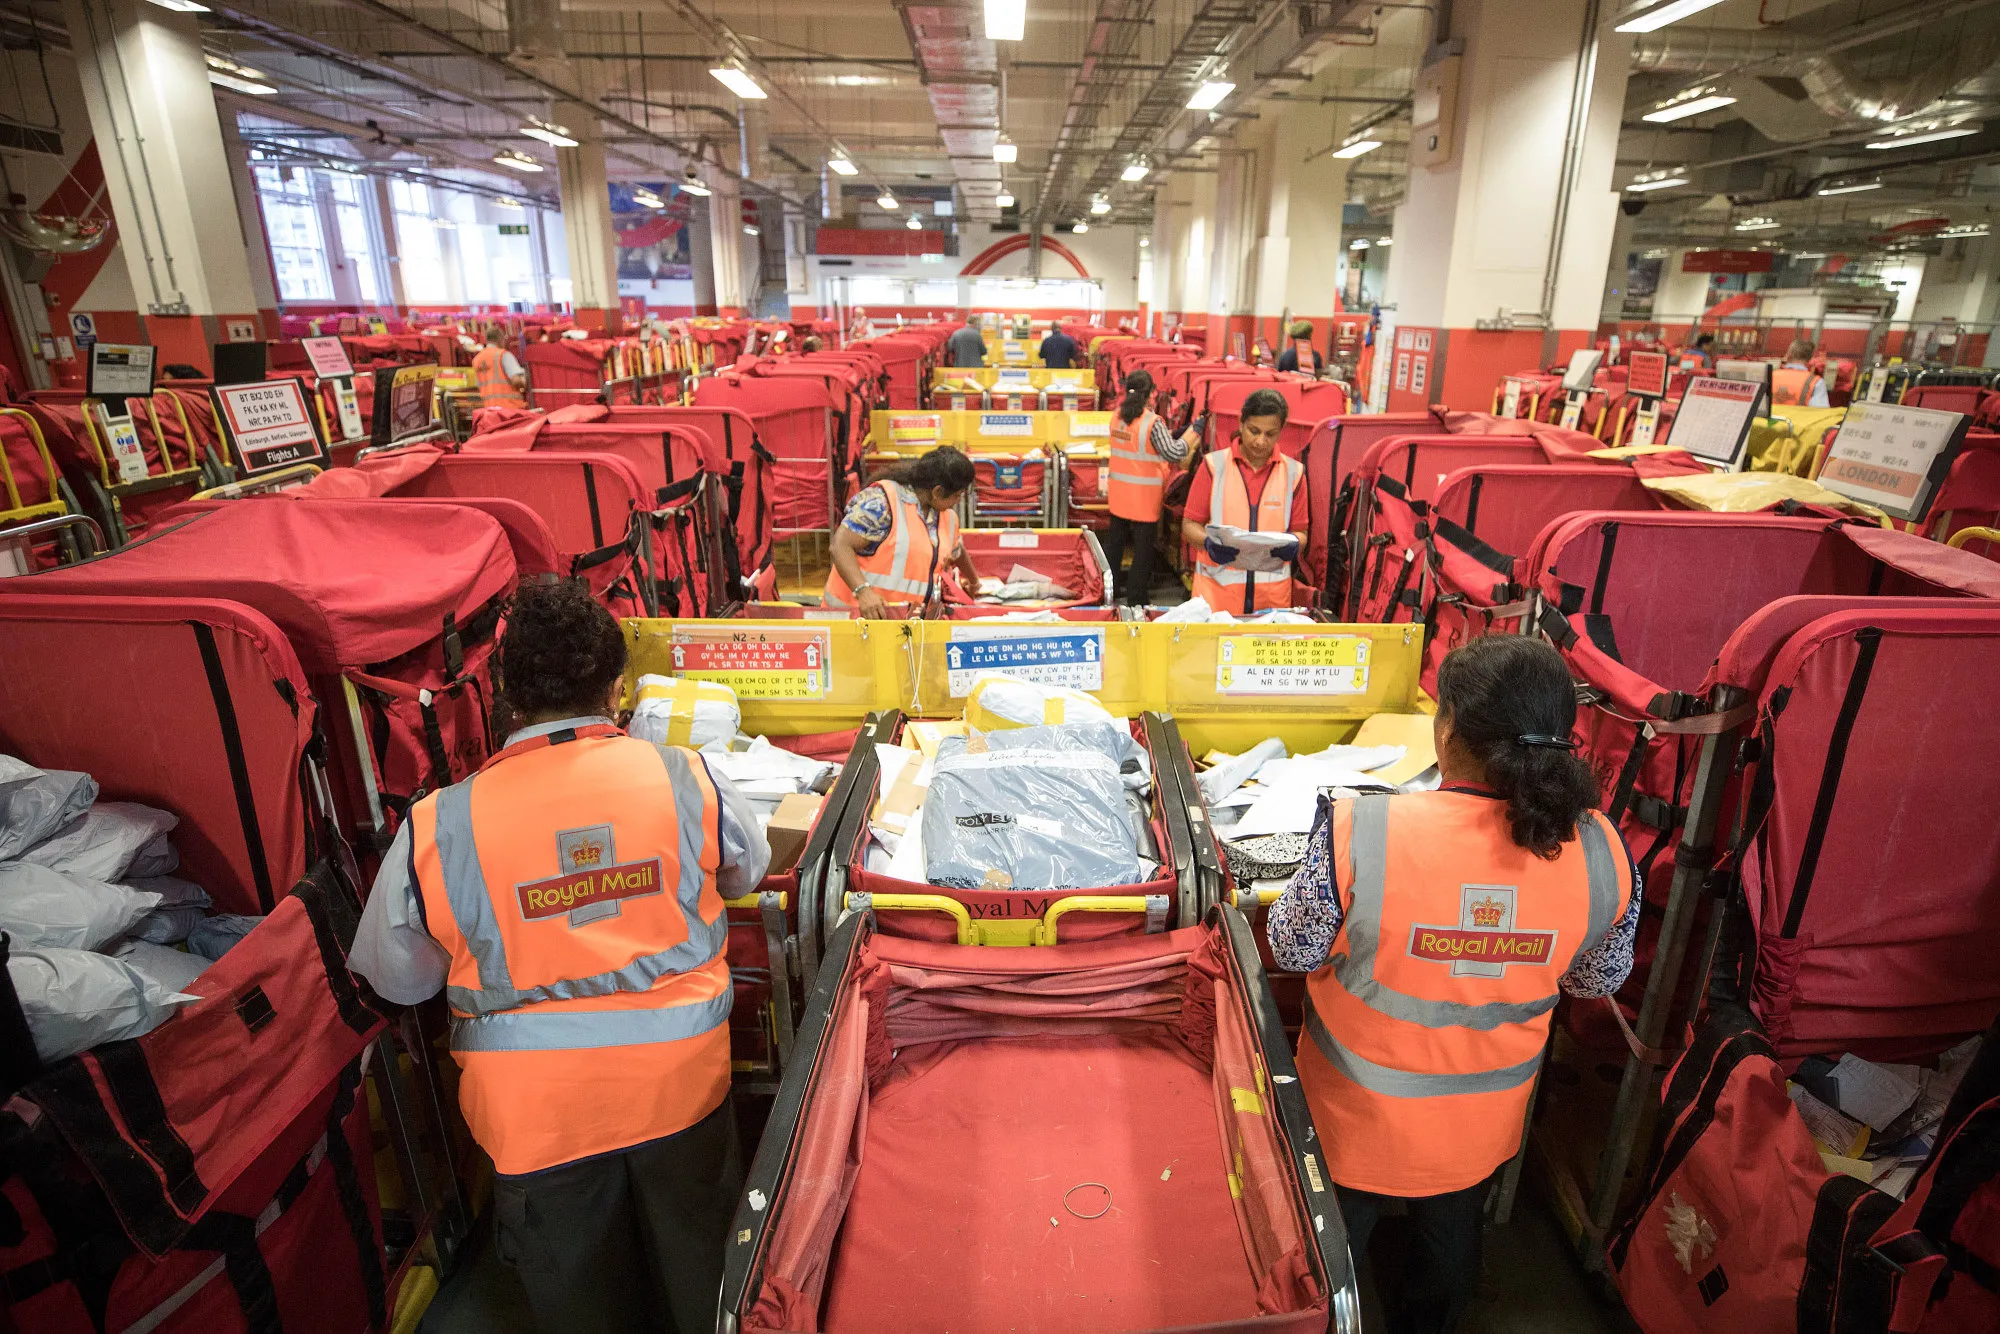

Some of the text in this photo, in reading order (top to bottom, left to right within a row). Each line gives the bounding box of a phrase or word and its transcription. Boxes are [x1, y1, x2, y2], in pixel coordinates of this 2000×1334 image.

[239, 394, 248, 402] BT
[250, 392, 262, 401] BX2
[275, 390, 284, 398] EH
[243, 406, 252, 414] FK
[260, 403, 268, 411] KA
[279, 401, 288, 409] ML
[263, 416, 272, 424] PA
[273, 415, 282, 423] PH
[283, 413, 292, 421] TD
[266, 447, 300, 463] Flights A
[1837, 464, 1901, 488] LONDON
[733, 633, 746, 642] N2
[759, 633, 766, 642] 6
[972, 655, 981, 663] LE
[527, 866, 653, 910] Royal Mail
[1420, 933, 1545, 957] Royal Mail
